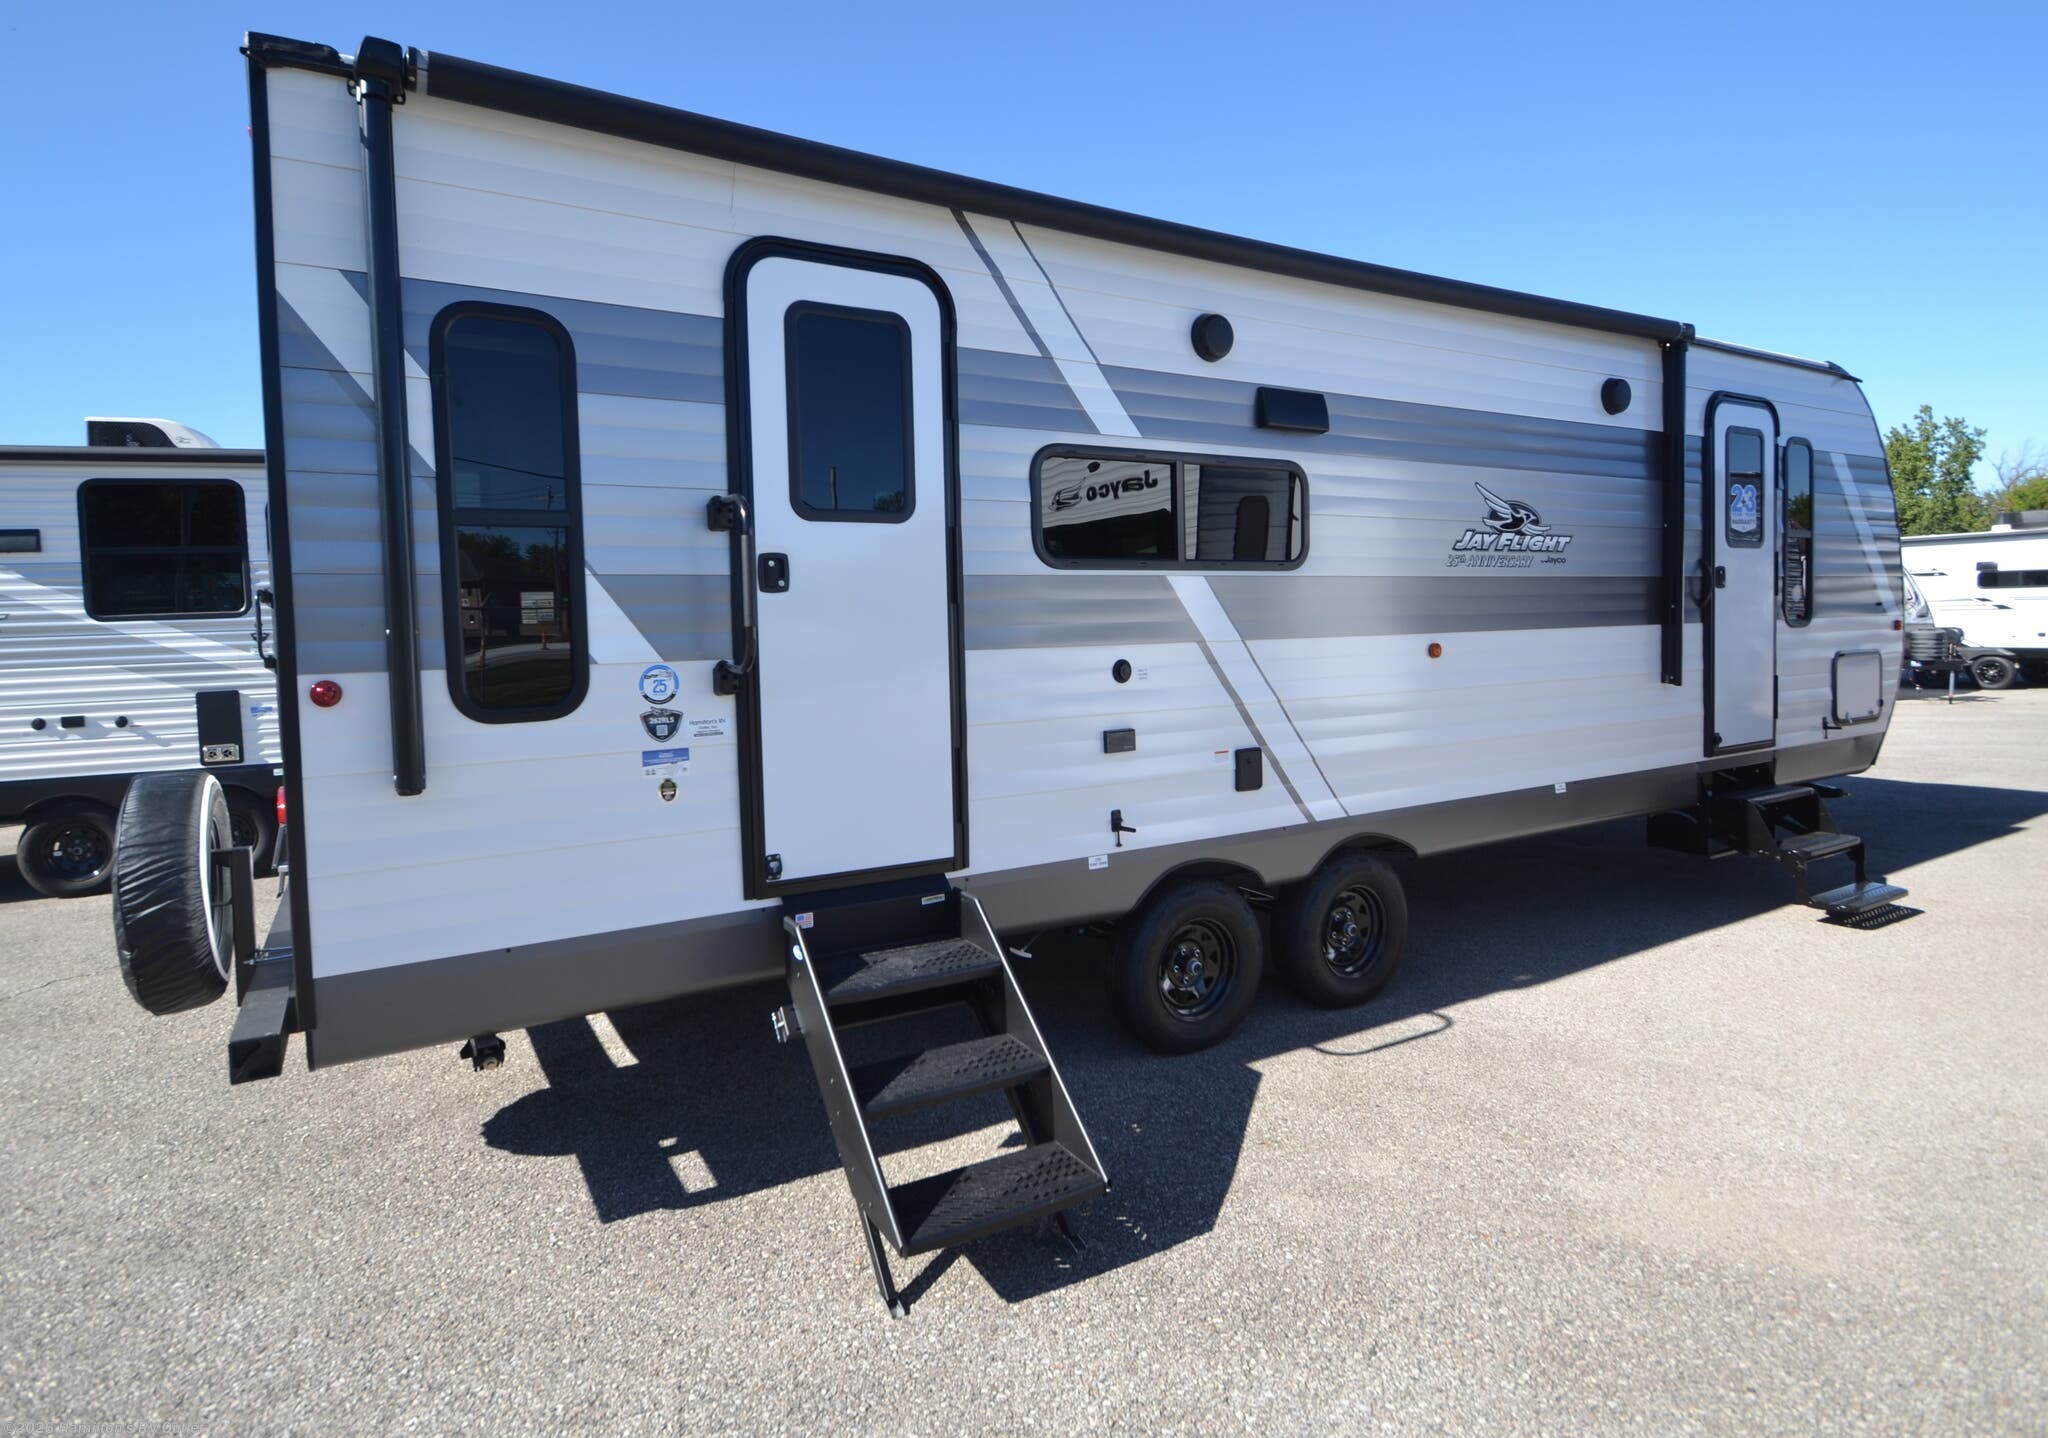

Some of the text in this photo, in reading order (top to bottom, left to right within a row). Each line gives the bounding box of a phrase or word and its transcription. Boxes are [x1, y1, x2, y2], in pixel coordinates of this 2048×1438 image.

[1453, 529, 1572, 552] JAY FLIGHT
[1466, 554, 1534, 568] ANNIVERSARY
[1547, 555, 1566, 565] Jayco
[652, 679, 667, 693] 25
